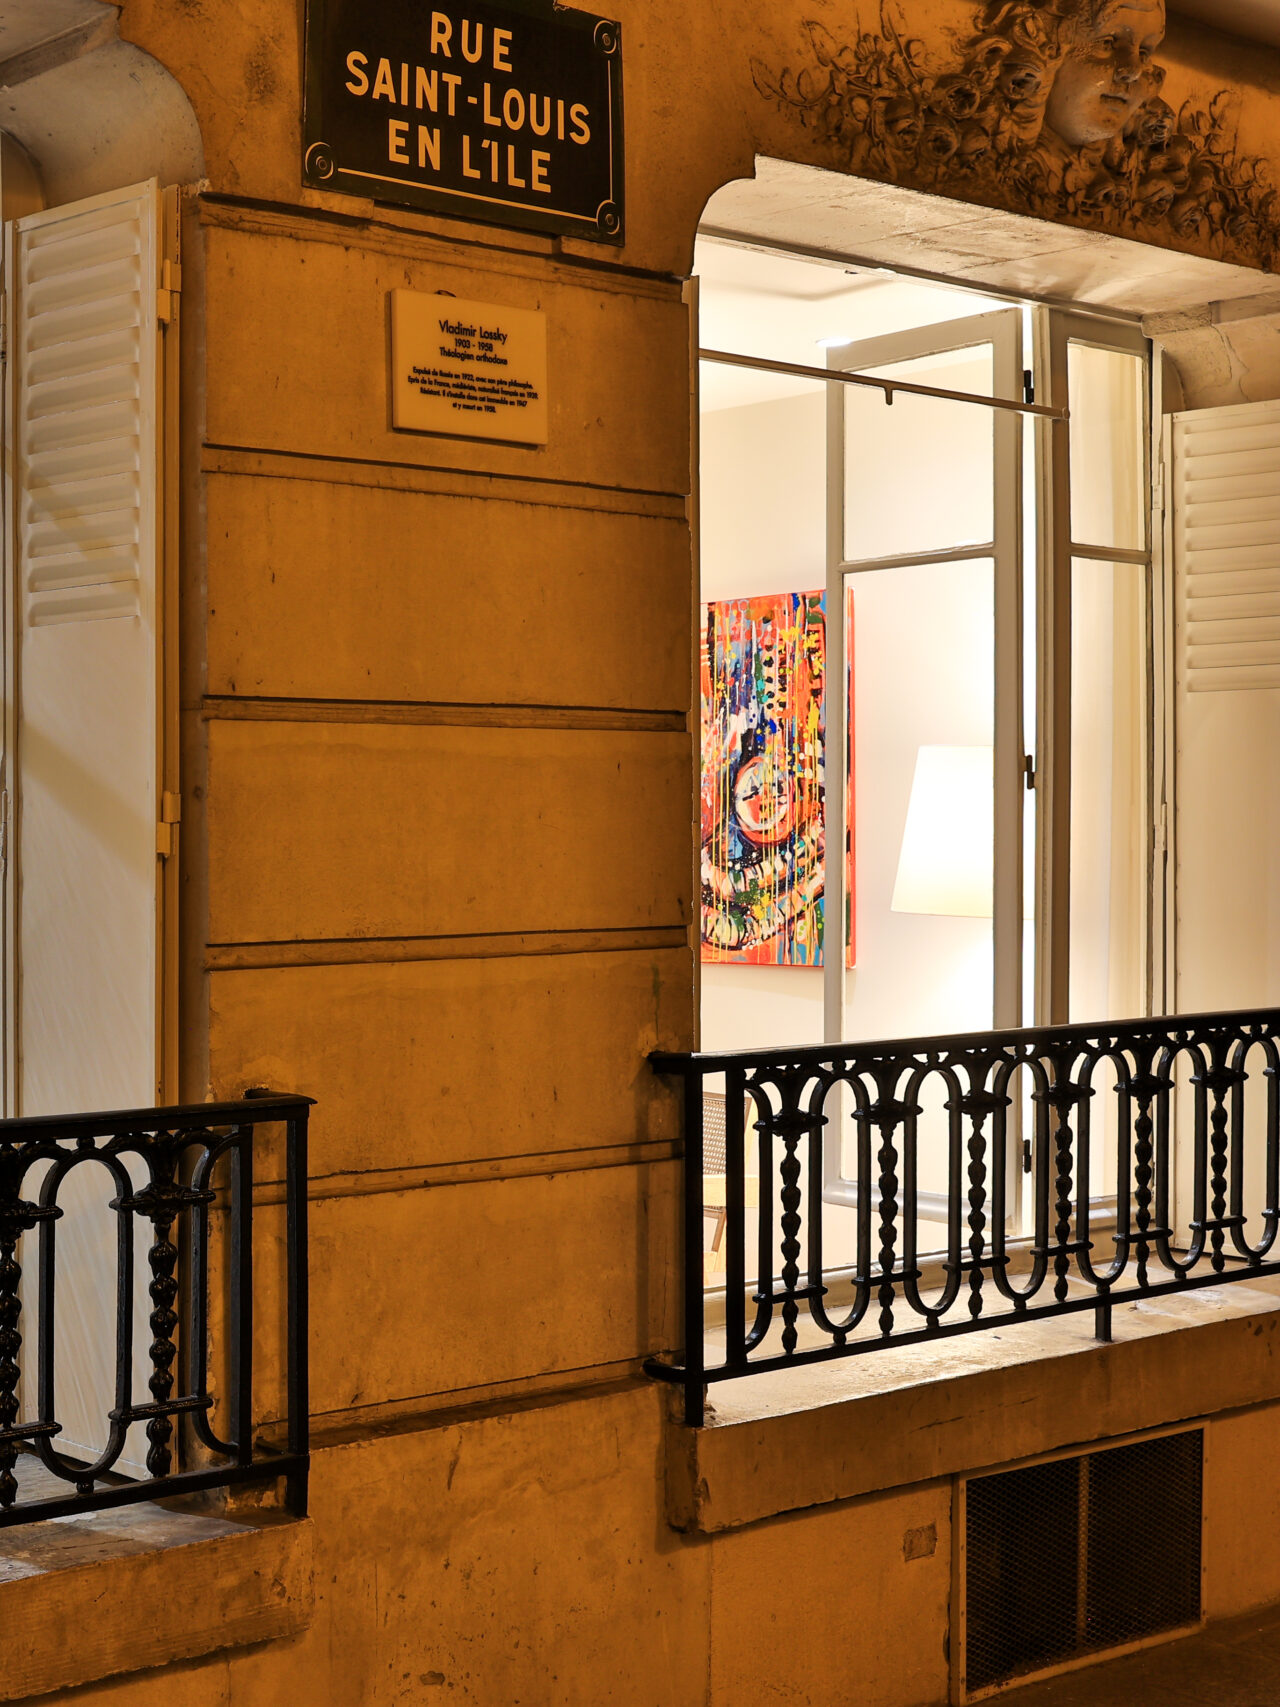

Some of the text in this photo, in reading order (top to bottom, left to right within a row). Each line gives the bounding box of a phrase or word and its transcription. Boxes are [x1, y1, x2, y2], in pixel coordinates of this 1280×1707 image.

[430, 11, 512, 73] RUE
[345, 50, 591, 145] SAINT-LOUIS
[388, 118, 441, 171] EN
[439, 320, 508, 345] Vladimir Lossky
[455, 338, 471, 348] 1903
[478, 342, 493, 352] 1958
[439, 347, 508, 365] Théologien orthodoxe
[421, 376, 427, 384] de
[428, 377, 433, 385] la
[434, 379, 451, 388] France,
[432, 368, 439, 376] de
[497, 378, 508, 386] père
[467, 392, 478, 401] dans
